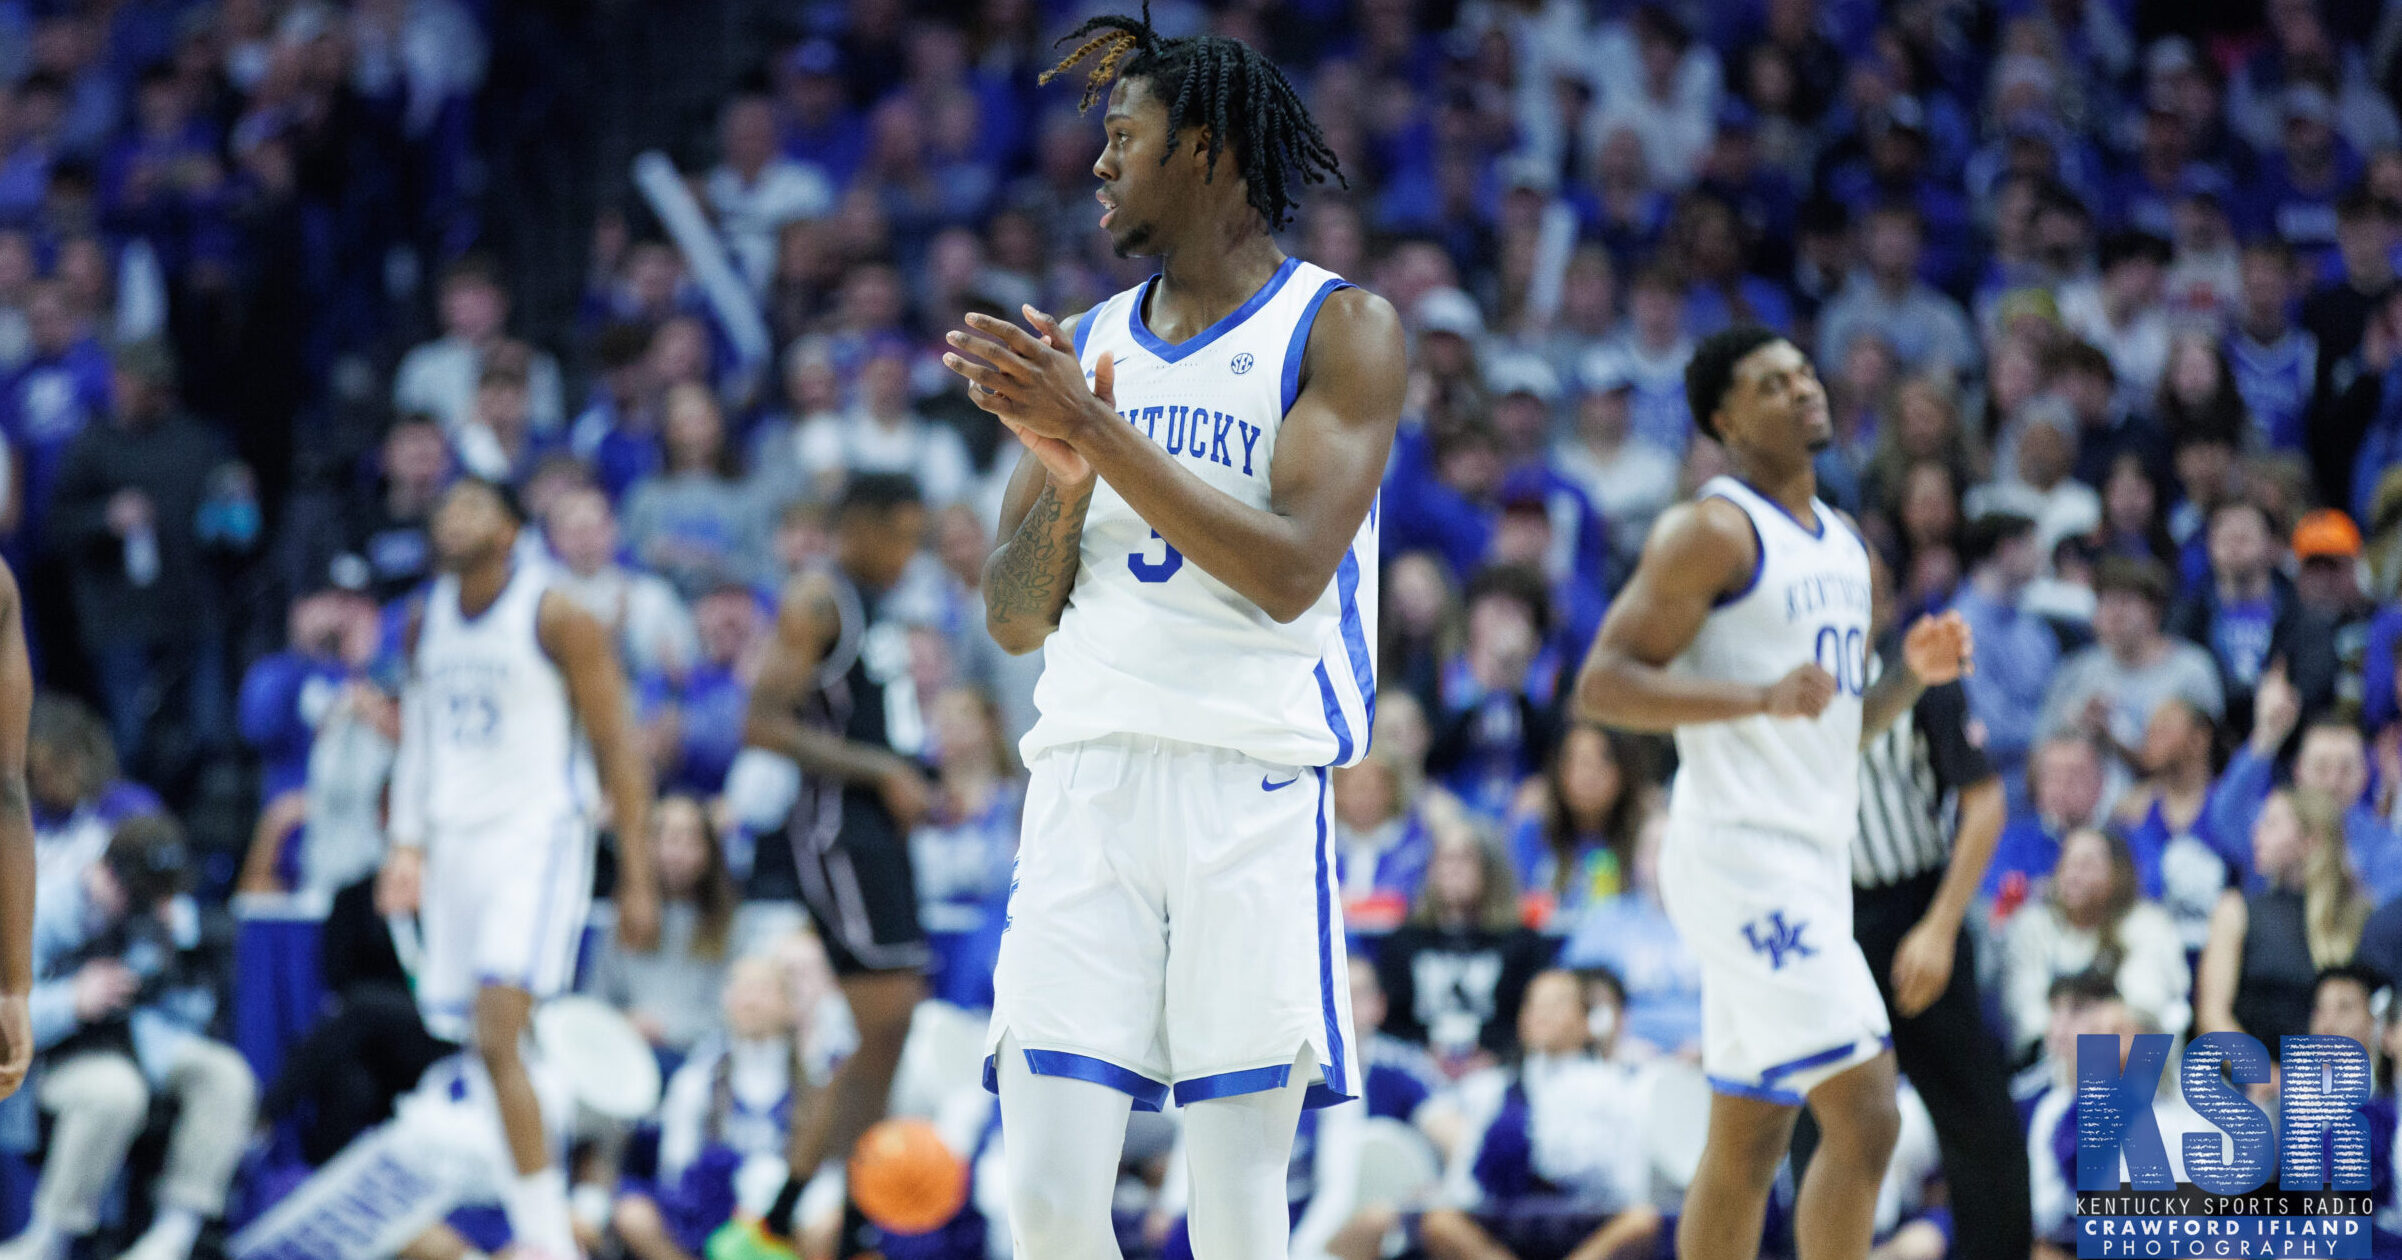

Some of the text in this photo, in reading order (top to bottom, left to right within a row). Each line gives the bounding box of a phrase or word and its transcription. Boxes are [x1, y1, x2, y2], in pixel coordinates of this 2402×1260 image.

[1231, 353, 1254, 375] SEC
[1116, 405, 1261, 477] TUCKY
[1127, 527, 1183, 583] 3
[1816, 625, 1864, 697] 00
